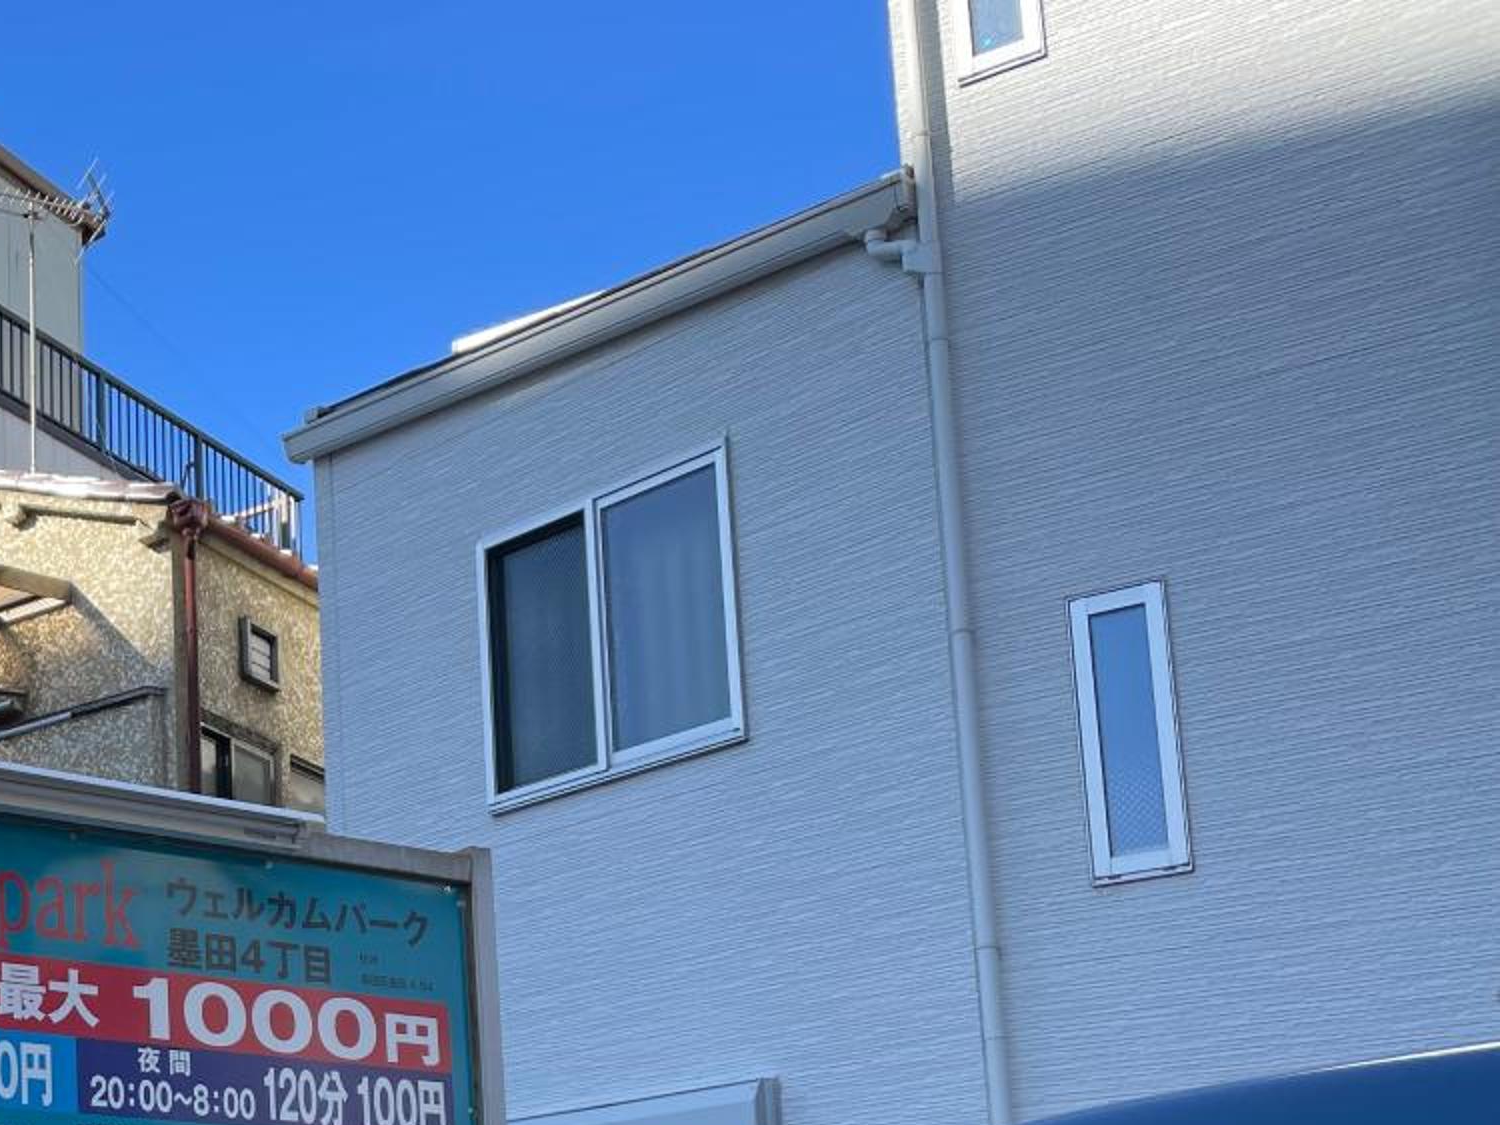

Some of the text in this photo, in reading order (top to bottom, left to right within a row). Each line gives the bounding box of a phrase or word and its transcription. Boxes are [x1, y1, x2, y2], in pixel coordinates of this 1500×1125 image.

[167, 927, 331, 984] 墨田4丁目
[133, 977, 440, 1066] 1000円
[137, 1047, 192, 1077] 夜間
